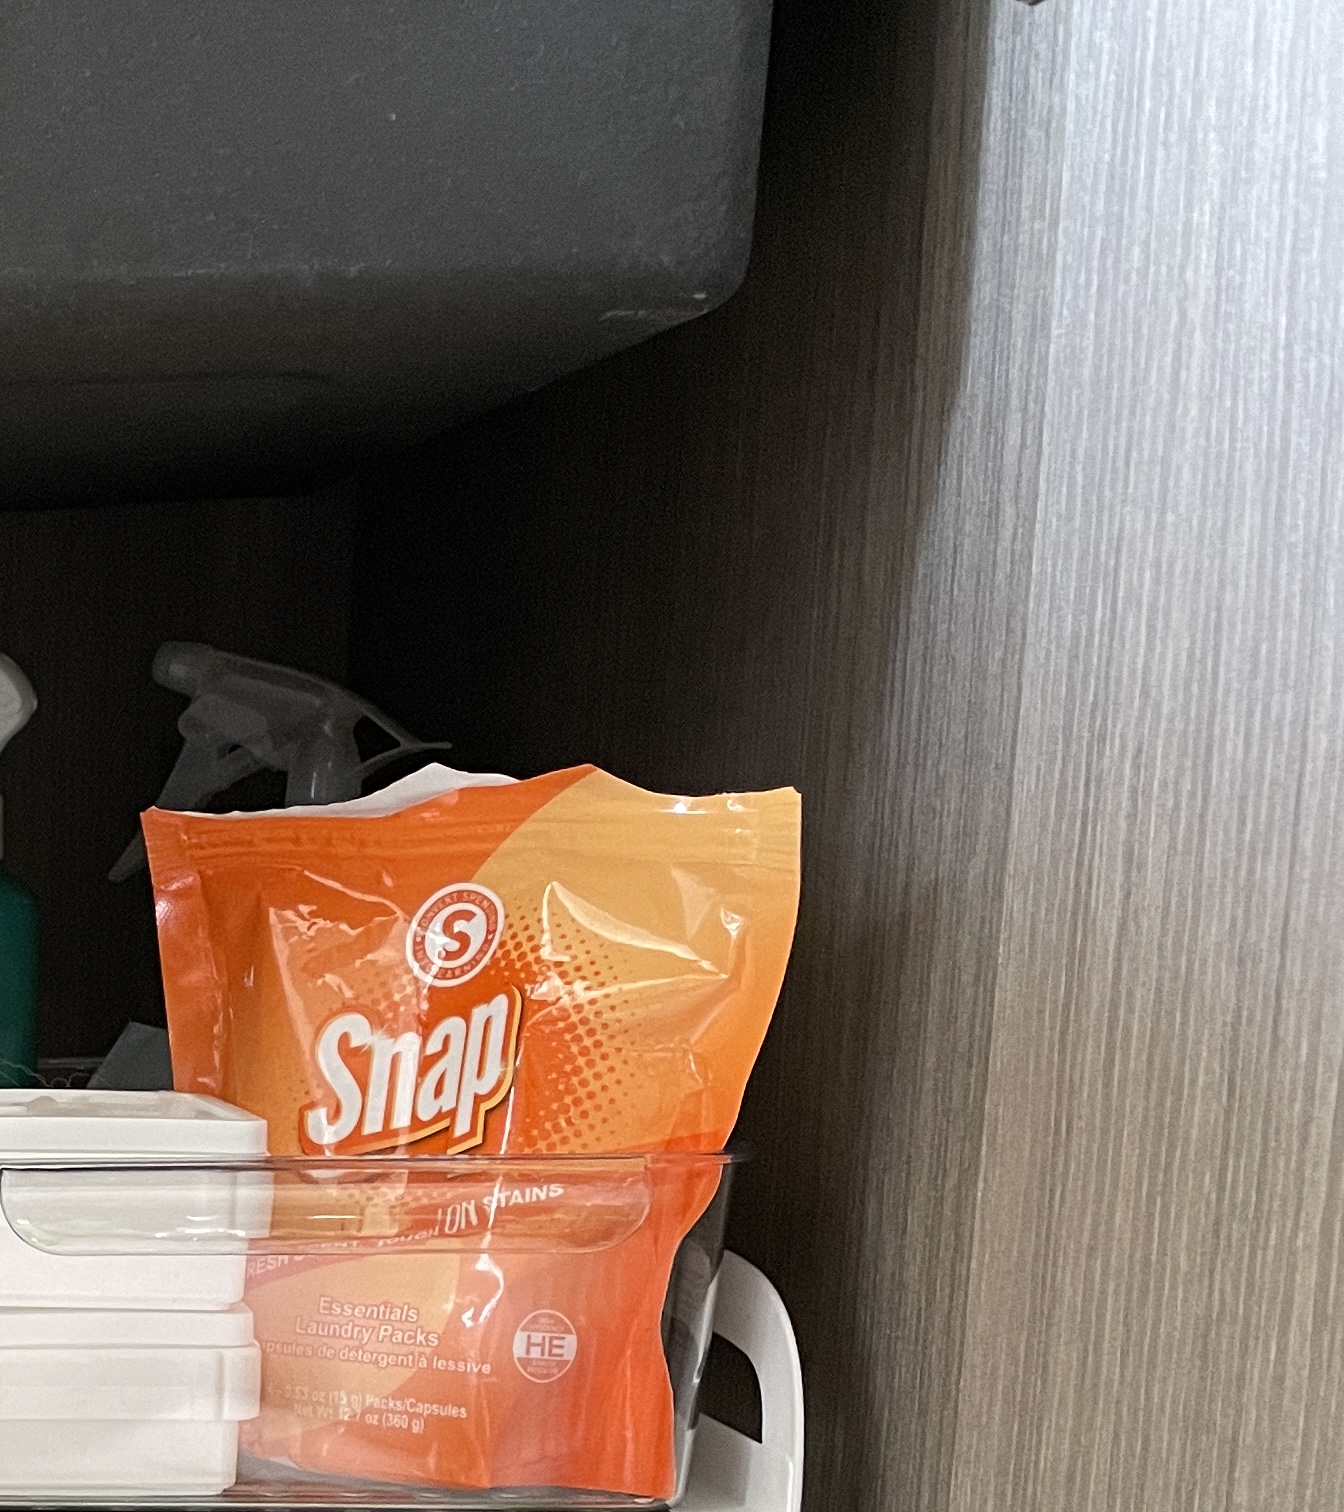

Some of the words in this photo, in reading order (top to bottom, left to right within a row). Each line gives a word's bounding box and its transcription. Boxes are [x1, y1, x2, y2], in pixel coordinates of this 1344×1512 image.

[308, 994, 509, 1145] Snap
[482, 1183, 564, 1214] STAINS
[318, 1296, 419, 1323] Essentials
[295, 1316, 373, 1345] Laundry
[378, 1325, 440, 1348] Packs
[525, 1334, 566, 1357] HE
[317, 1344, 336, 1359] de
[432, 1358, 492, 1375] lessive
[365, 1393, 467, 1419] Packs/Capsules
